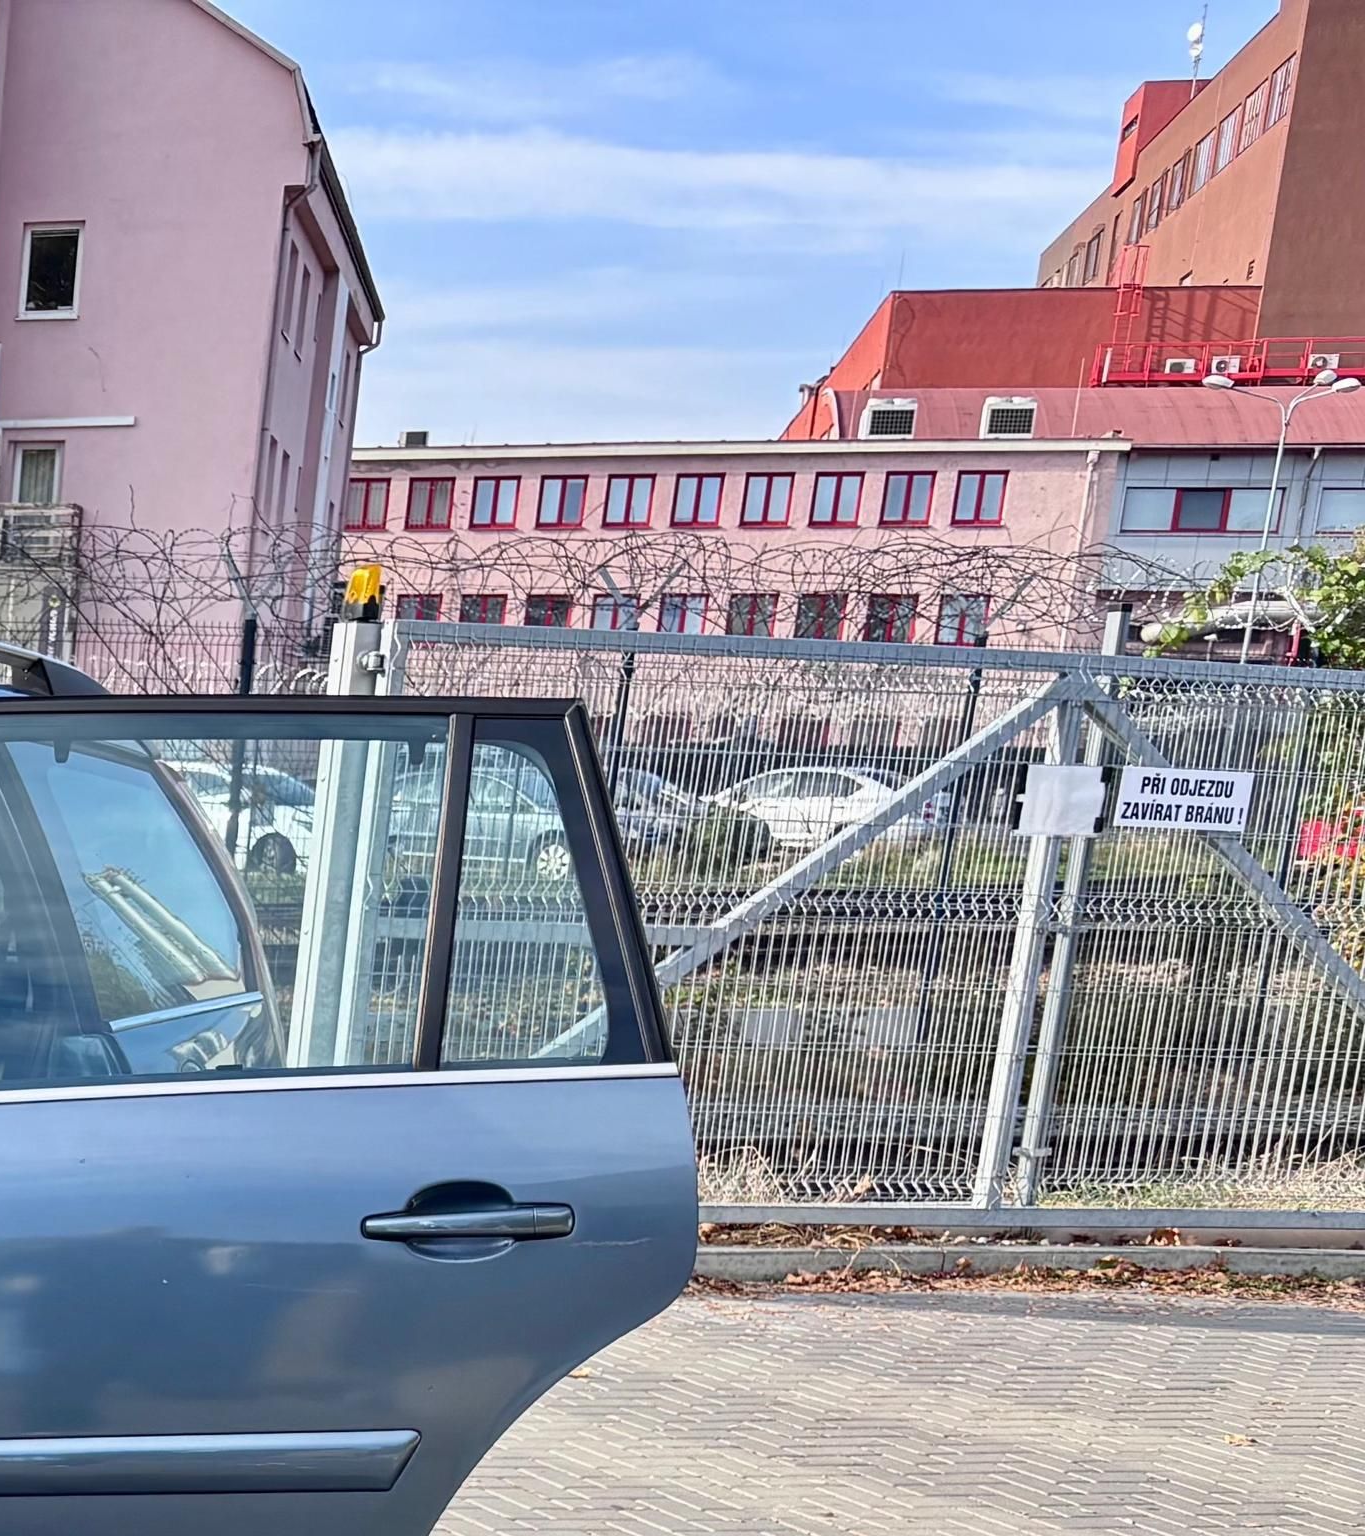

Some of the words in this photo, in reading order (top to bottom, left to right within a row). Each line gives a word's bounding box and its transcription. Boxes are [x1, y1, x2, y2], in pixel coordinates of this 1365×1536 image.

[1140, 773, 1166, 795] PŘI
[1170, 778, 1234, 798] ODJEZDU
[1121, 799, 1182, 822] ZAVÍRAT
[1184, 802, 1234, 825] BRÁNU
